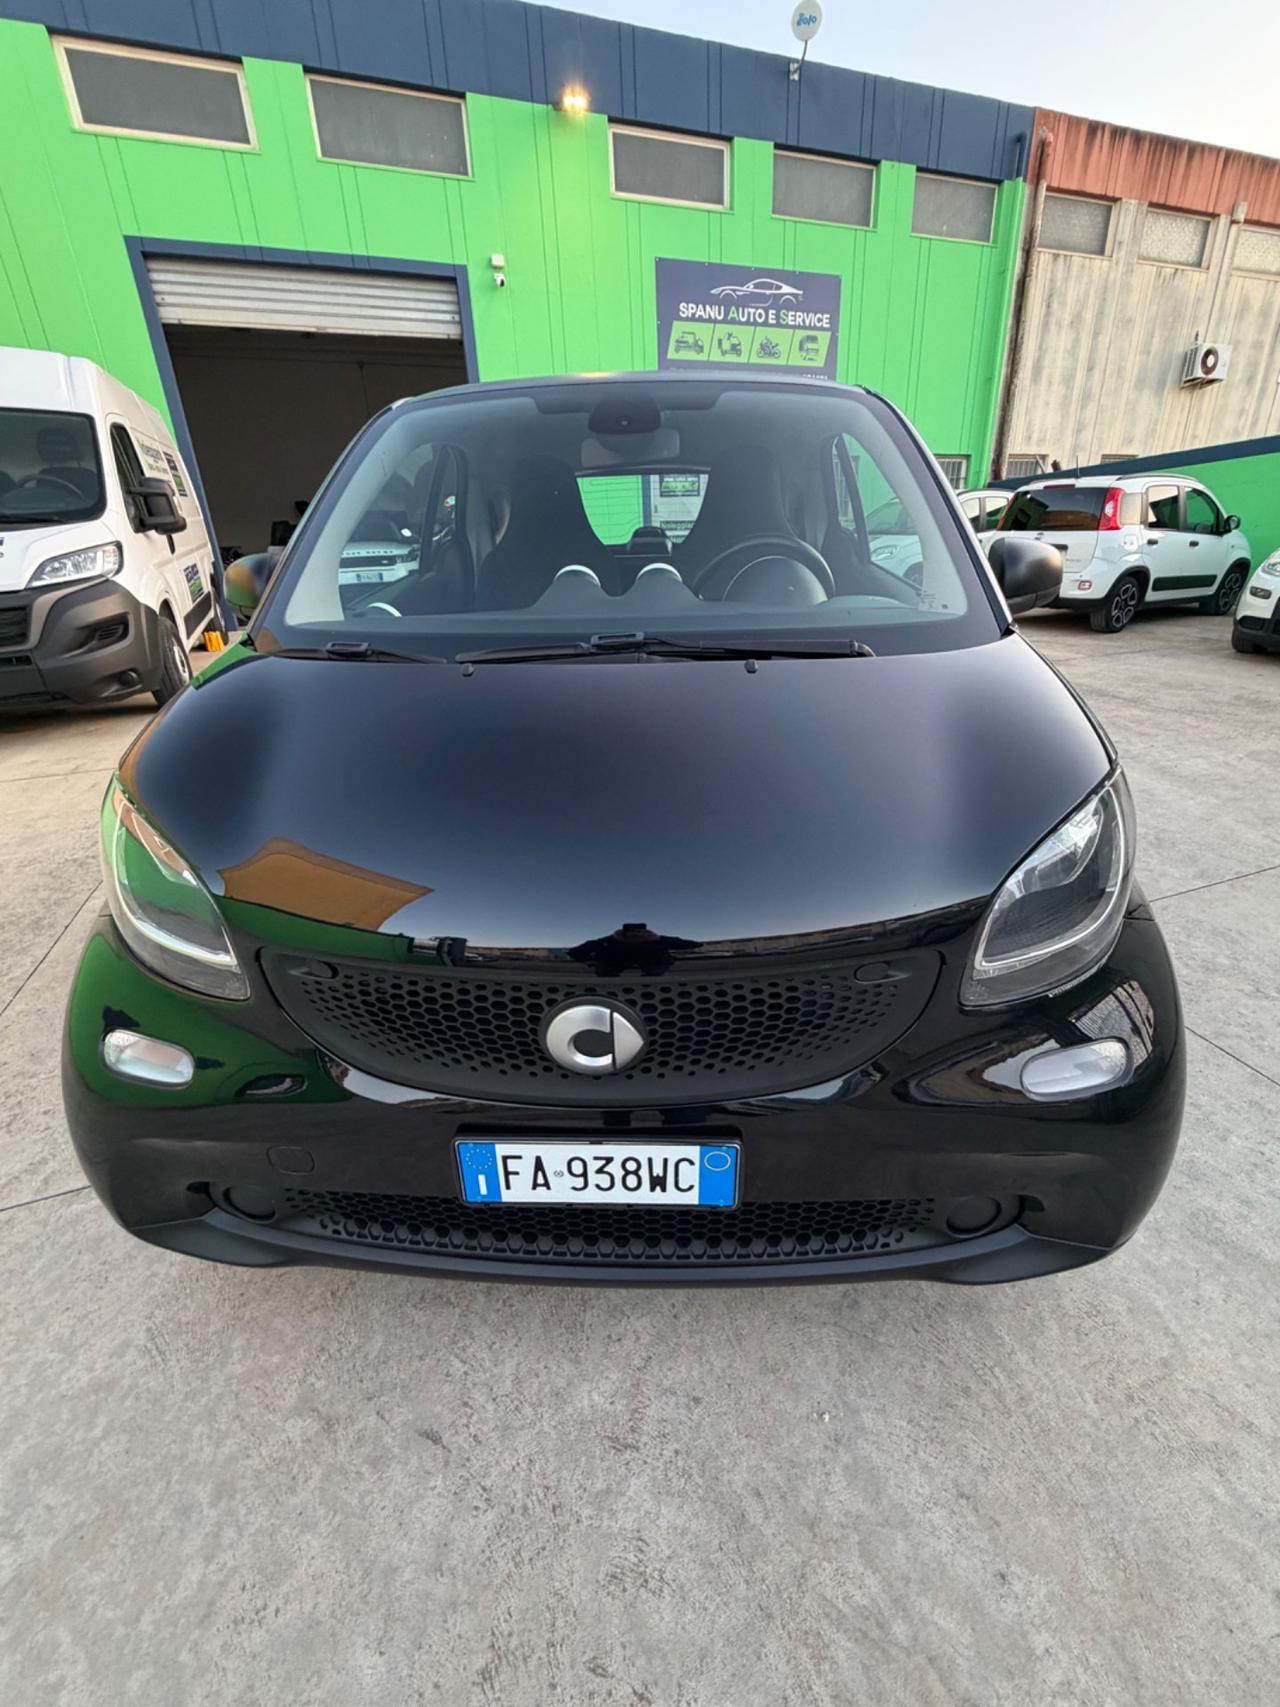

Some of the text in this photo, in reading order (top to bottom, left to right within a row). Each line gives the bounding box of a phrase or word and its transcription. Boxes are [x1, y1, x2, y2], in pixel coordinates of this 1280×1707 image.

[679, 302, 831, 328] SPANU AUTO E SERVICE
[501, 1154, 551, 1191] FA
[566, 1155, 696, 1193] 938WC
